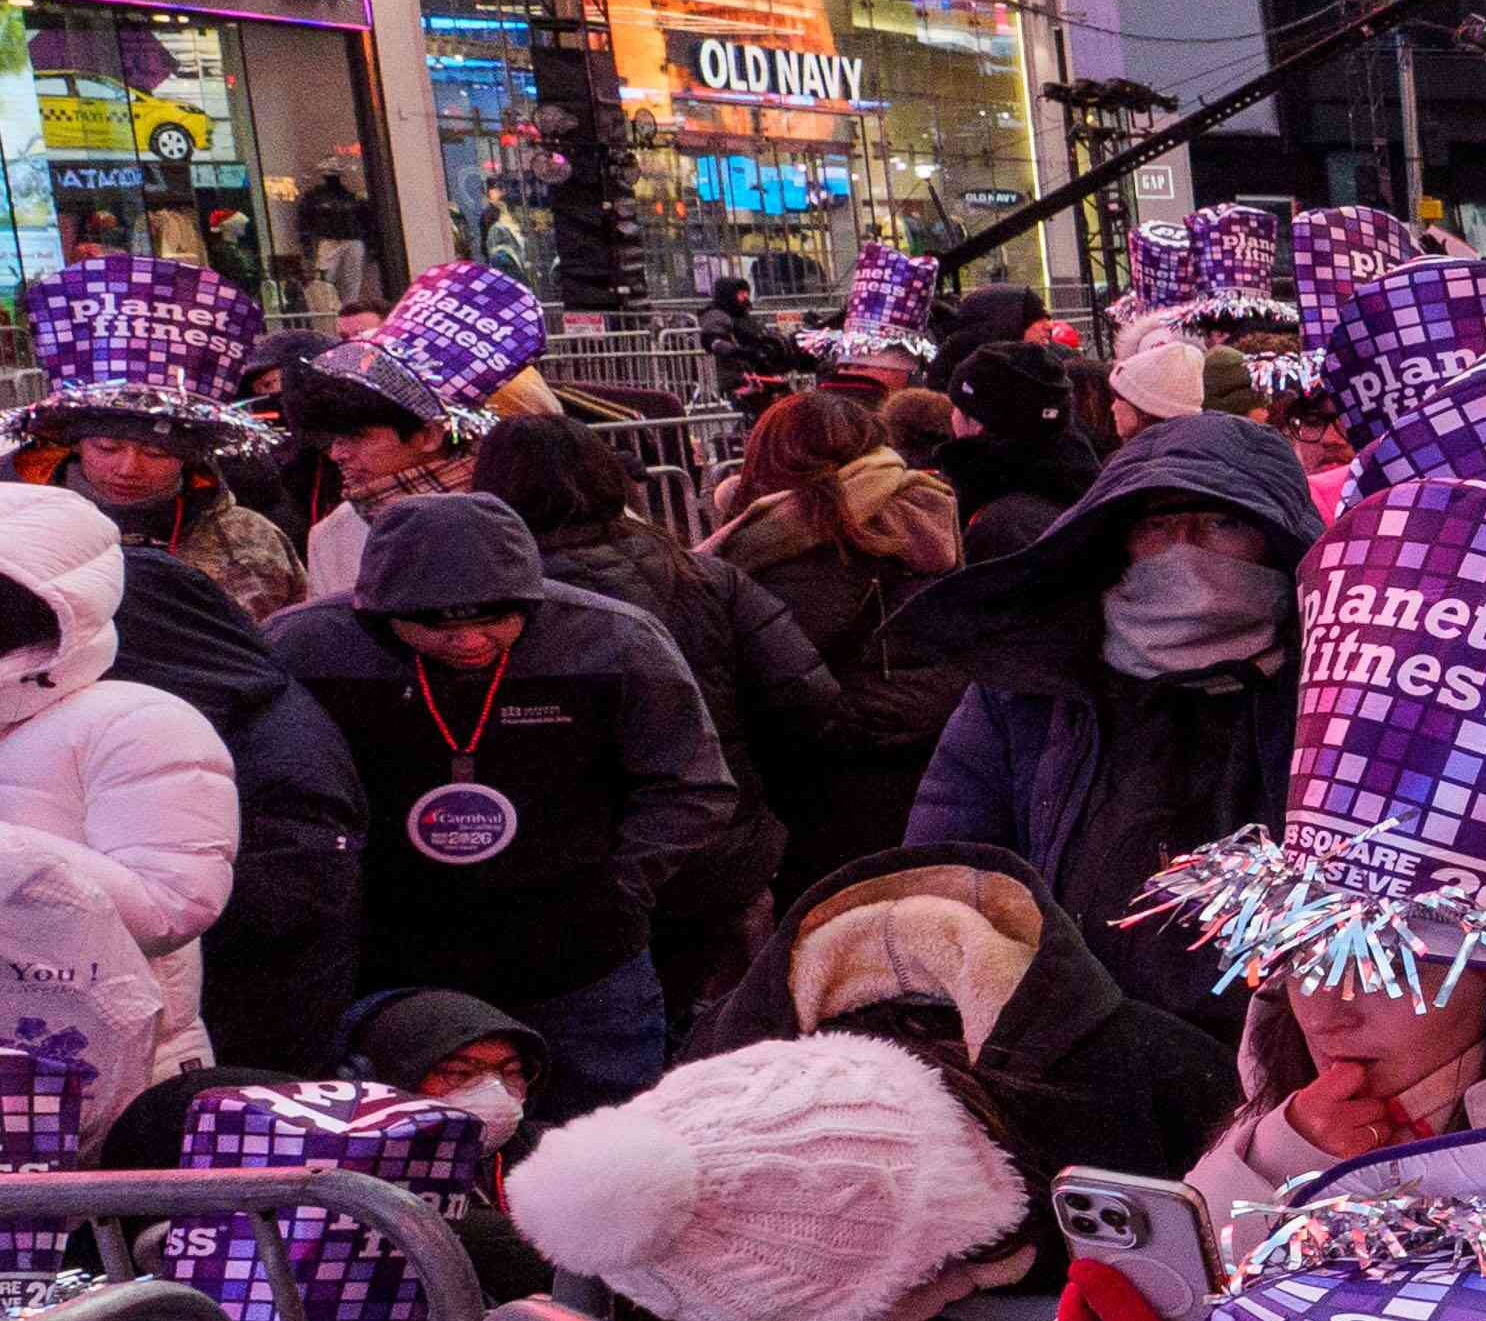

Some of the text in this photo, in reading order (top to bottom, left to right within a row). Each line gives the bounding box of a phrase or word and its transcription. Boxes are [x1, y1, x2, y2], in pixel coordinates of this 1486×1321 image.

[700, 40, 862, 100] OLD NAVY
[1142, 175, 1164, 191] GAP
[70, 288, 231, 335] planet
[409, 288, 516, 344] planet
[94, 312, 244, 361] fitness
[404, 306, 511, 373] fitness
[439, 813, 502, 825] Carnival
[1357, 868, 1411, 900] EVE
[9, 962, 76, 983] You
